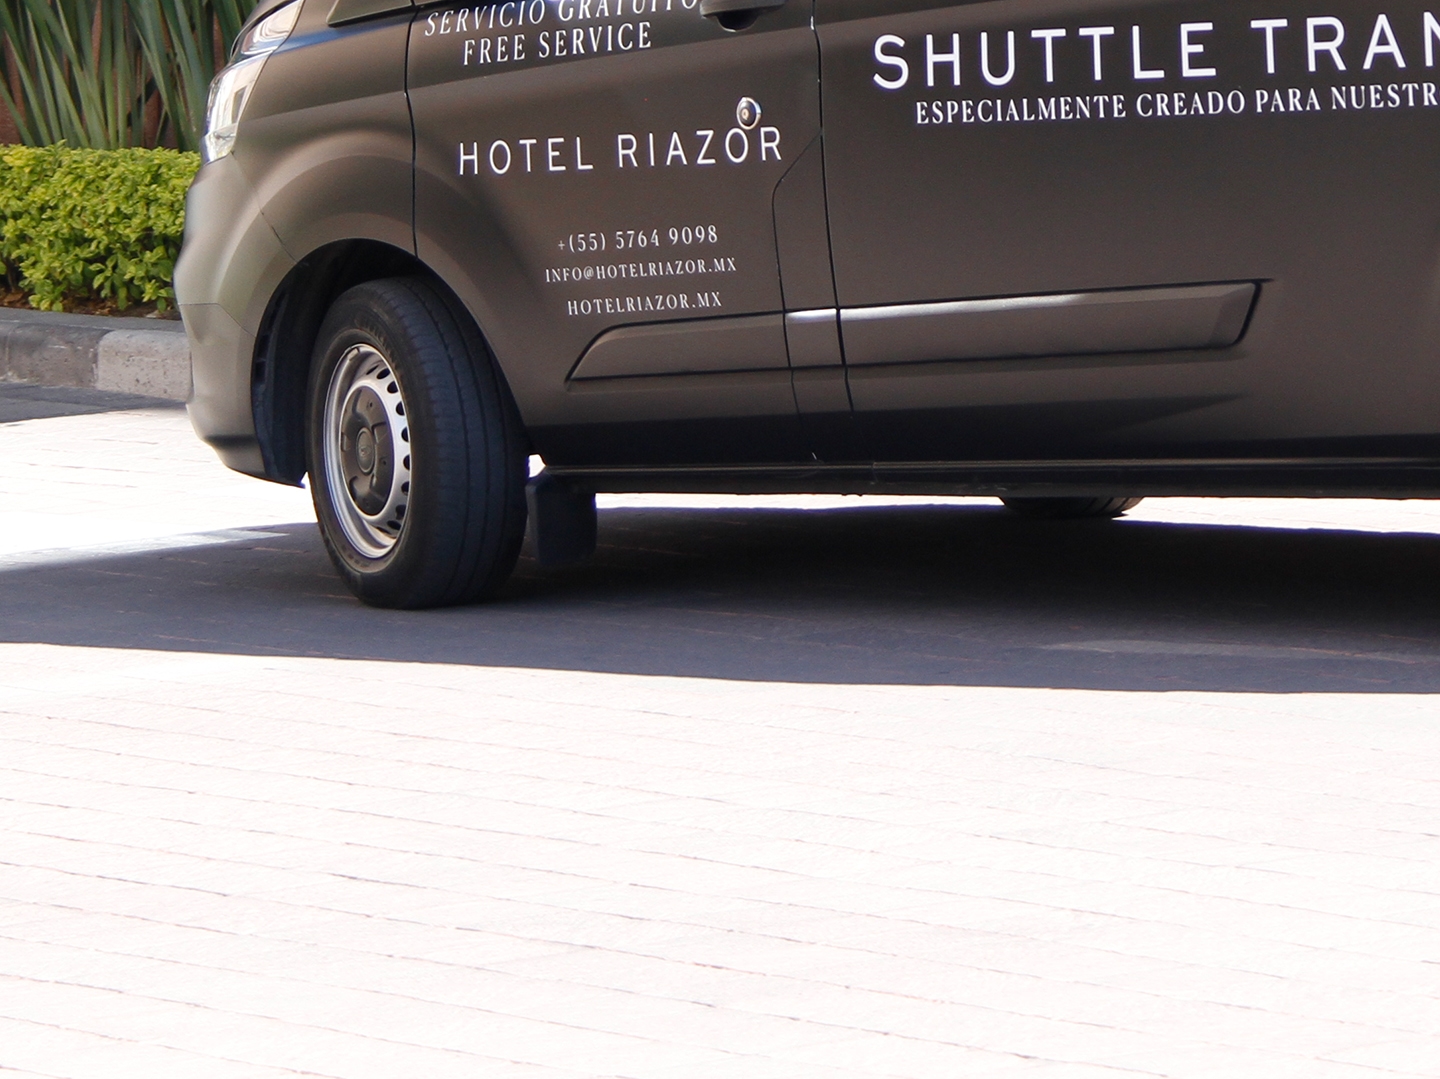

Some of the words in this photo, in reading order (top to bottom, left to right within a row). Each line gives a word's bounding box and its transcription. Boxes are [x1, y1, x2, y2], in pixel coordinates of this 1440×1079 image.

[463, 33, 527, 66] FREE
[538, 21, 653, 59] SERVICE
[872, 21, 1217, 90] SHUTTLE
[915, 94, 1127, 125] ESPECIALMENTE
[1136, 89, 1246, 118] CREADO
[1255, 87, 1323, 114] PARA
[458, 135, 594, 176] HOTEL
[617, 126, 782, 168] RIAZOR
[558, 232, 607, 254] +(55)
[615, 228, 661, 250] 5764
[669, 224, 719, 246] 9098
[545, 256, 738, 283] INFO@HOTELRIAZOR.MX
[567, 290, 723, 316] HOTELRIAZOR.MX
